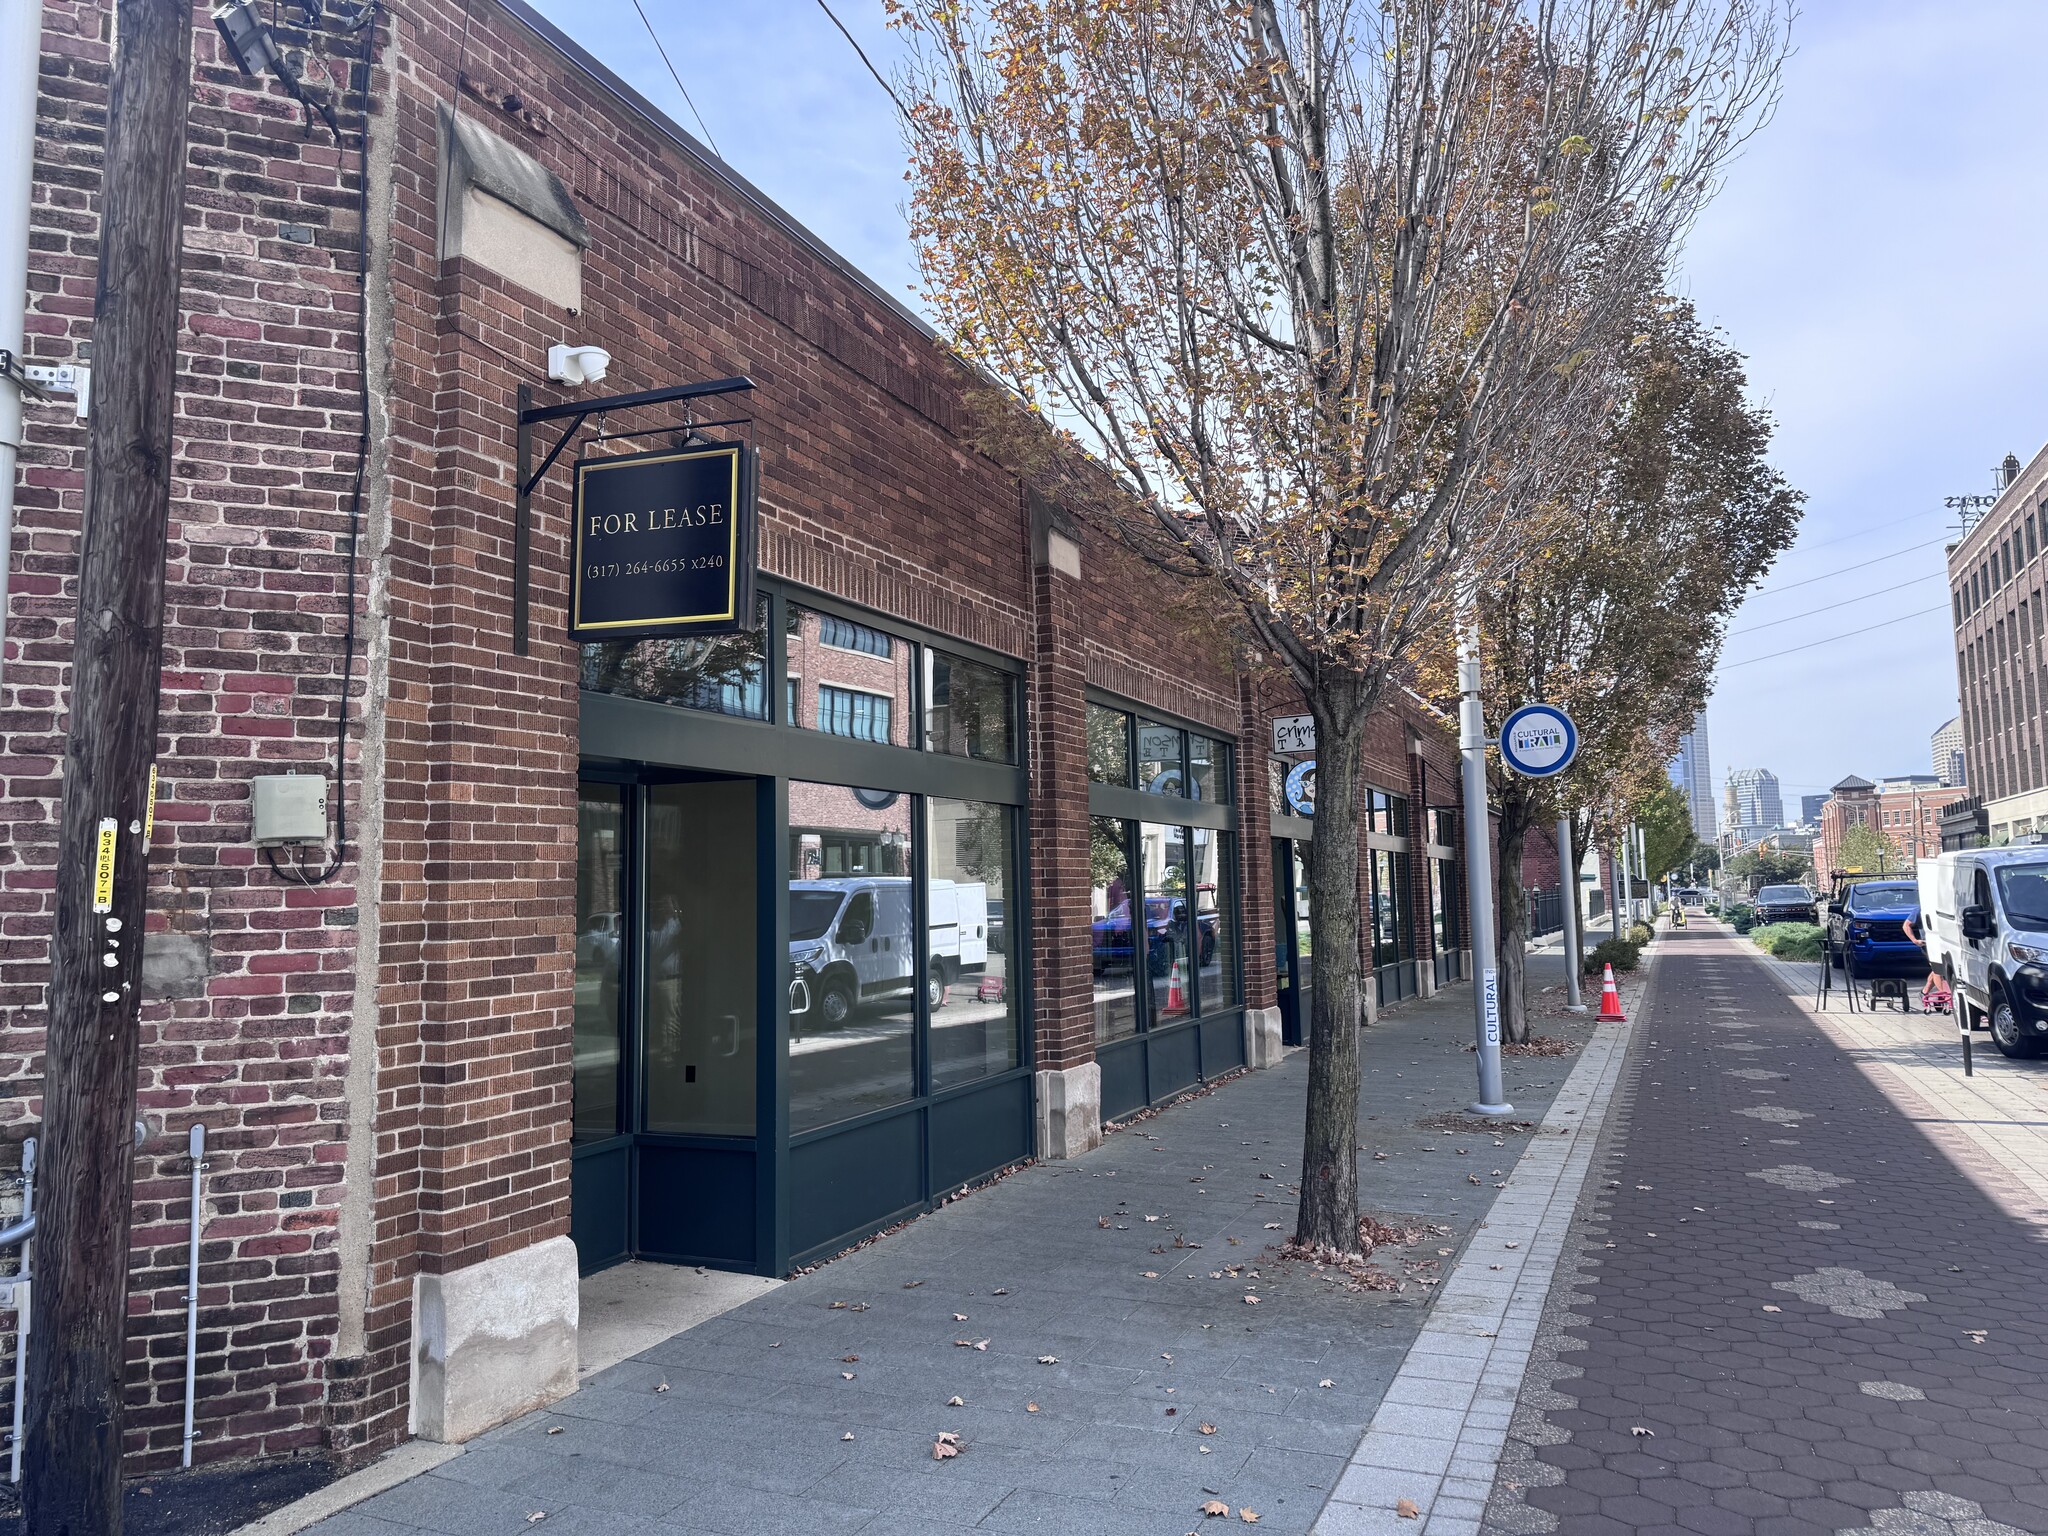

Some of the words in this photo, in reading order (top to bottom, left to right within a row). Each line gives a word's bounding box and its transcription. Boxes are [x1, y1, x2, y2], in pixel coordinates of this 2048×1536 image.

[589, 512, 639, 536] FOR
[648, 503, 724, 531] LEASE
[587, 562, 620, 579] (317)
[626, 558, 686, 576] 264-6655
[691, 555, 723, 570] x240
[1517, 727, 1560, 738] CULTURAL
[1518, 734, 1561, 749] TRAIL
[1485, 975, 1498, 1042] CULTURAL
